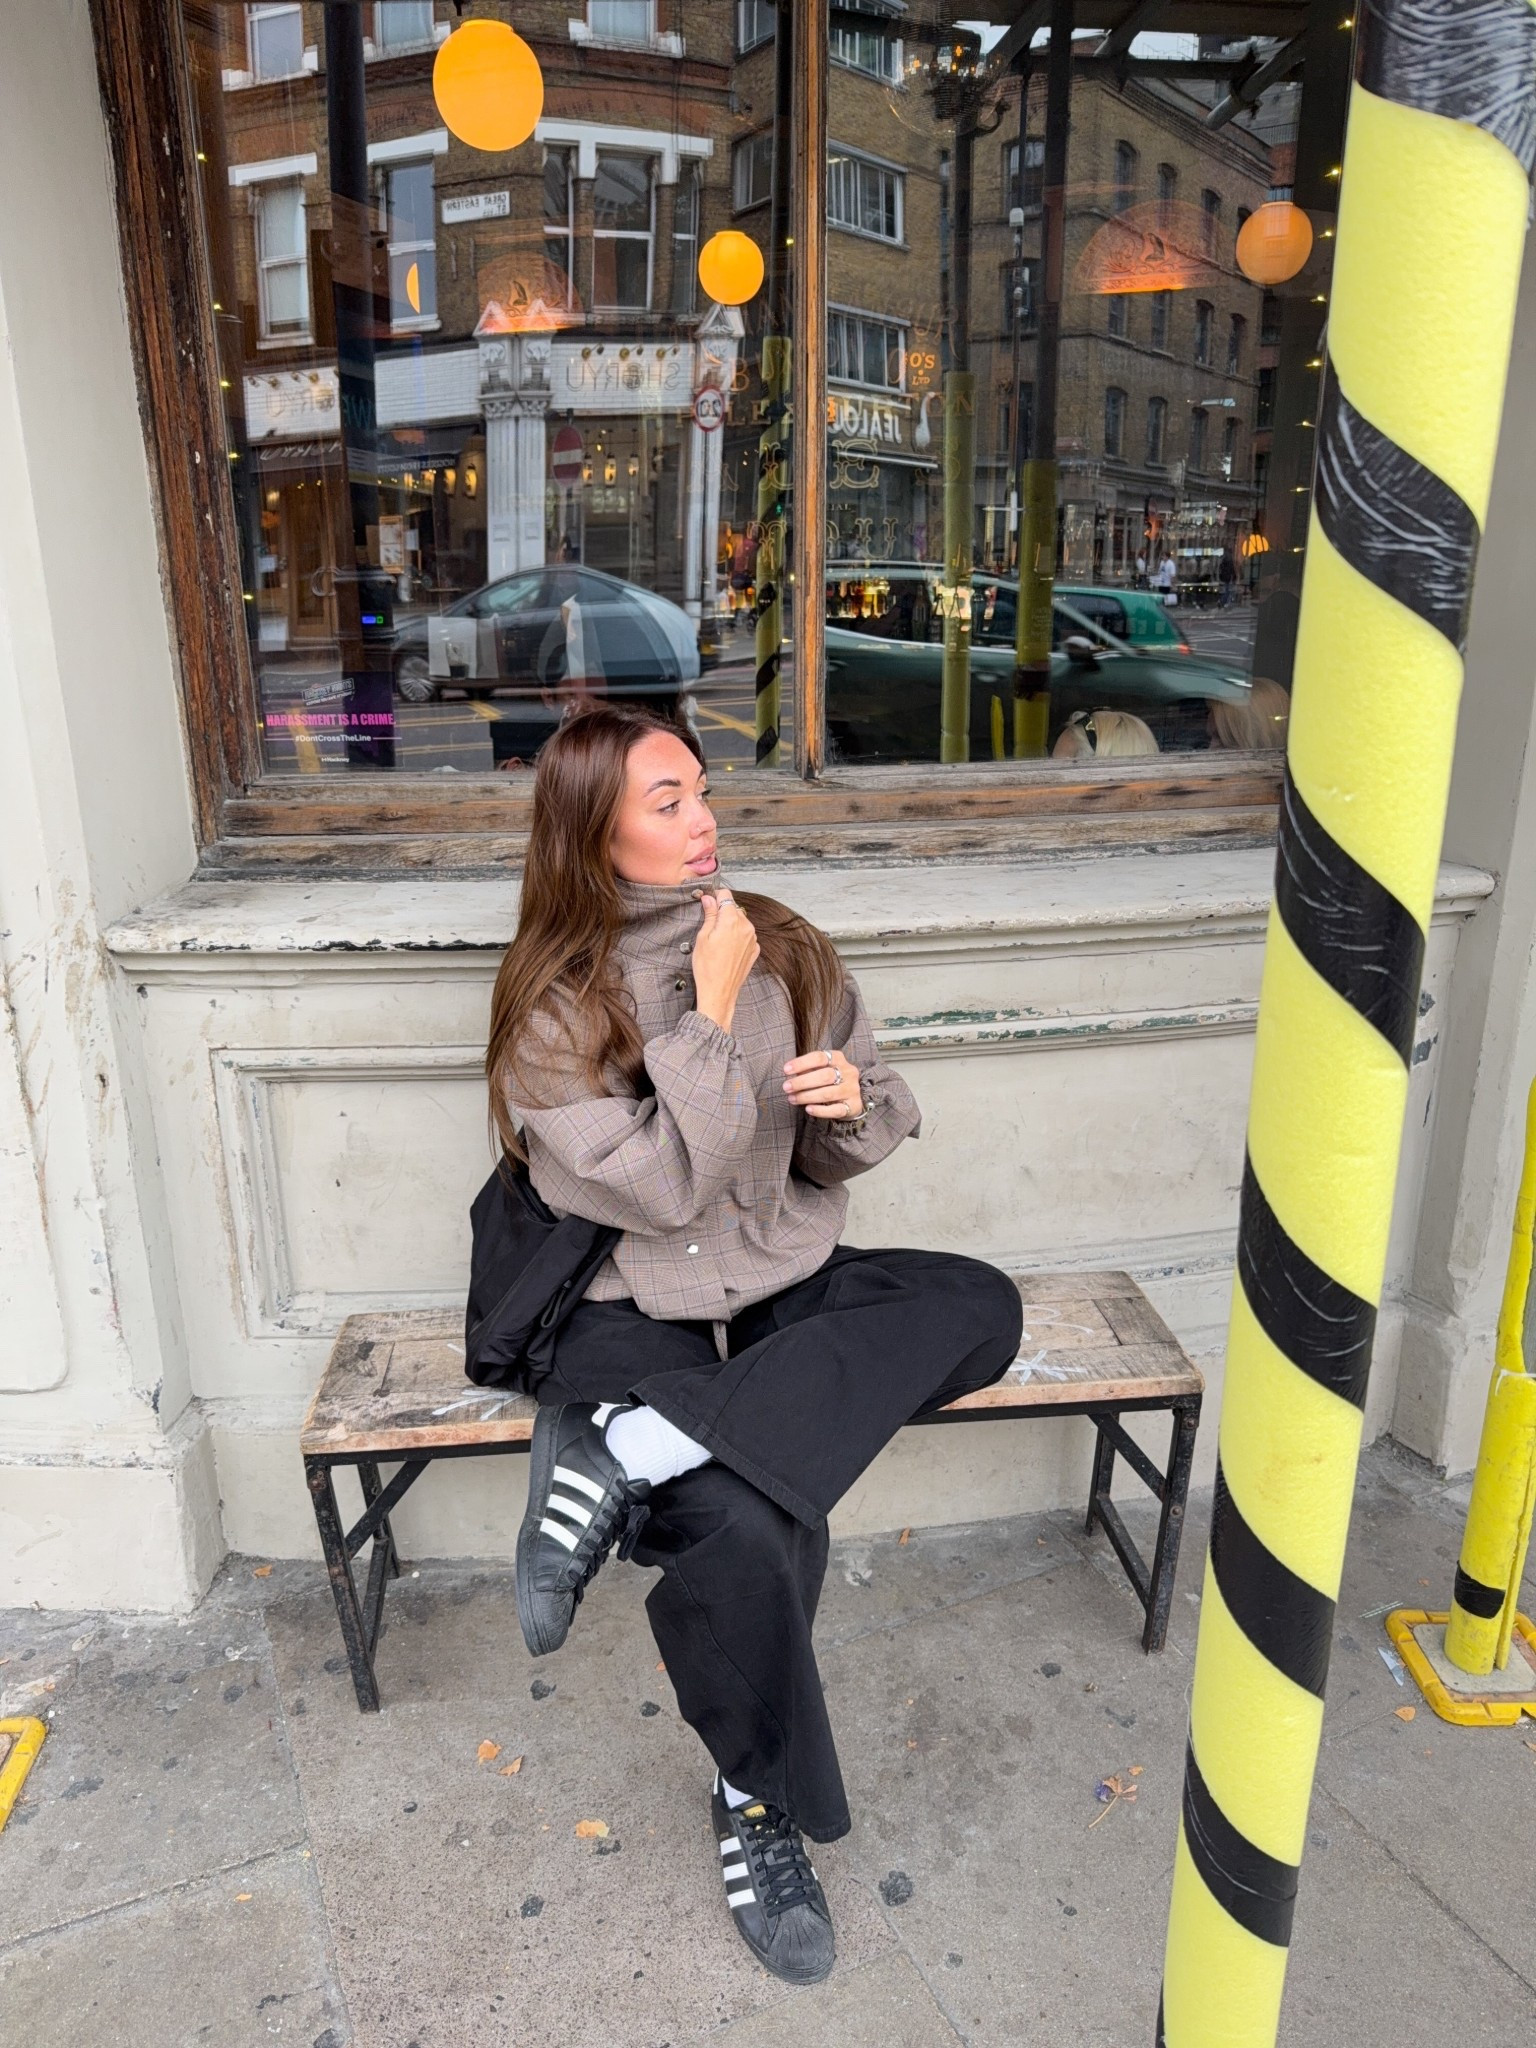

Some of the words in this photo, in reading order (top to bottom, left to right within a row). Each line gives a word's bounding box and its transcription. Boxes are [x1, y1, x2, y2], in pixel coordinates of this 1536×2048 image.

[266, 713, 336, 726] HARASSMENT
[338, 713, 349, 726] IS
[351, 713, 359, 725] A
[295, 734, 372, 742] #DontCrossTheLine
